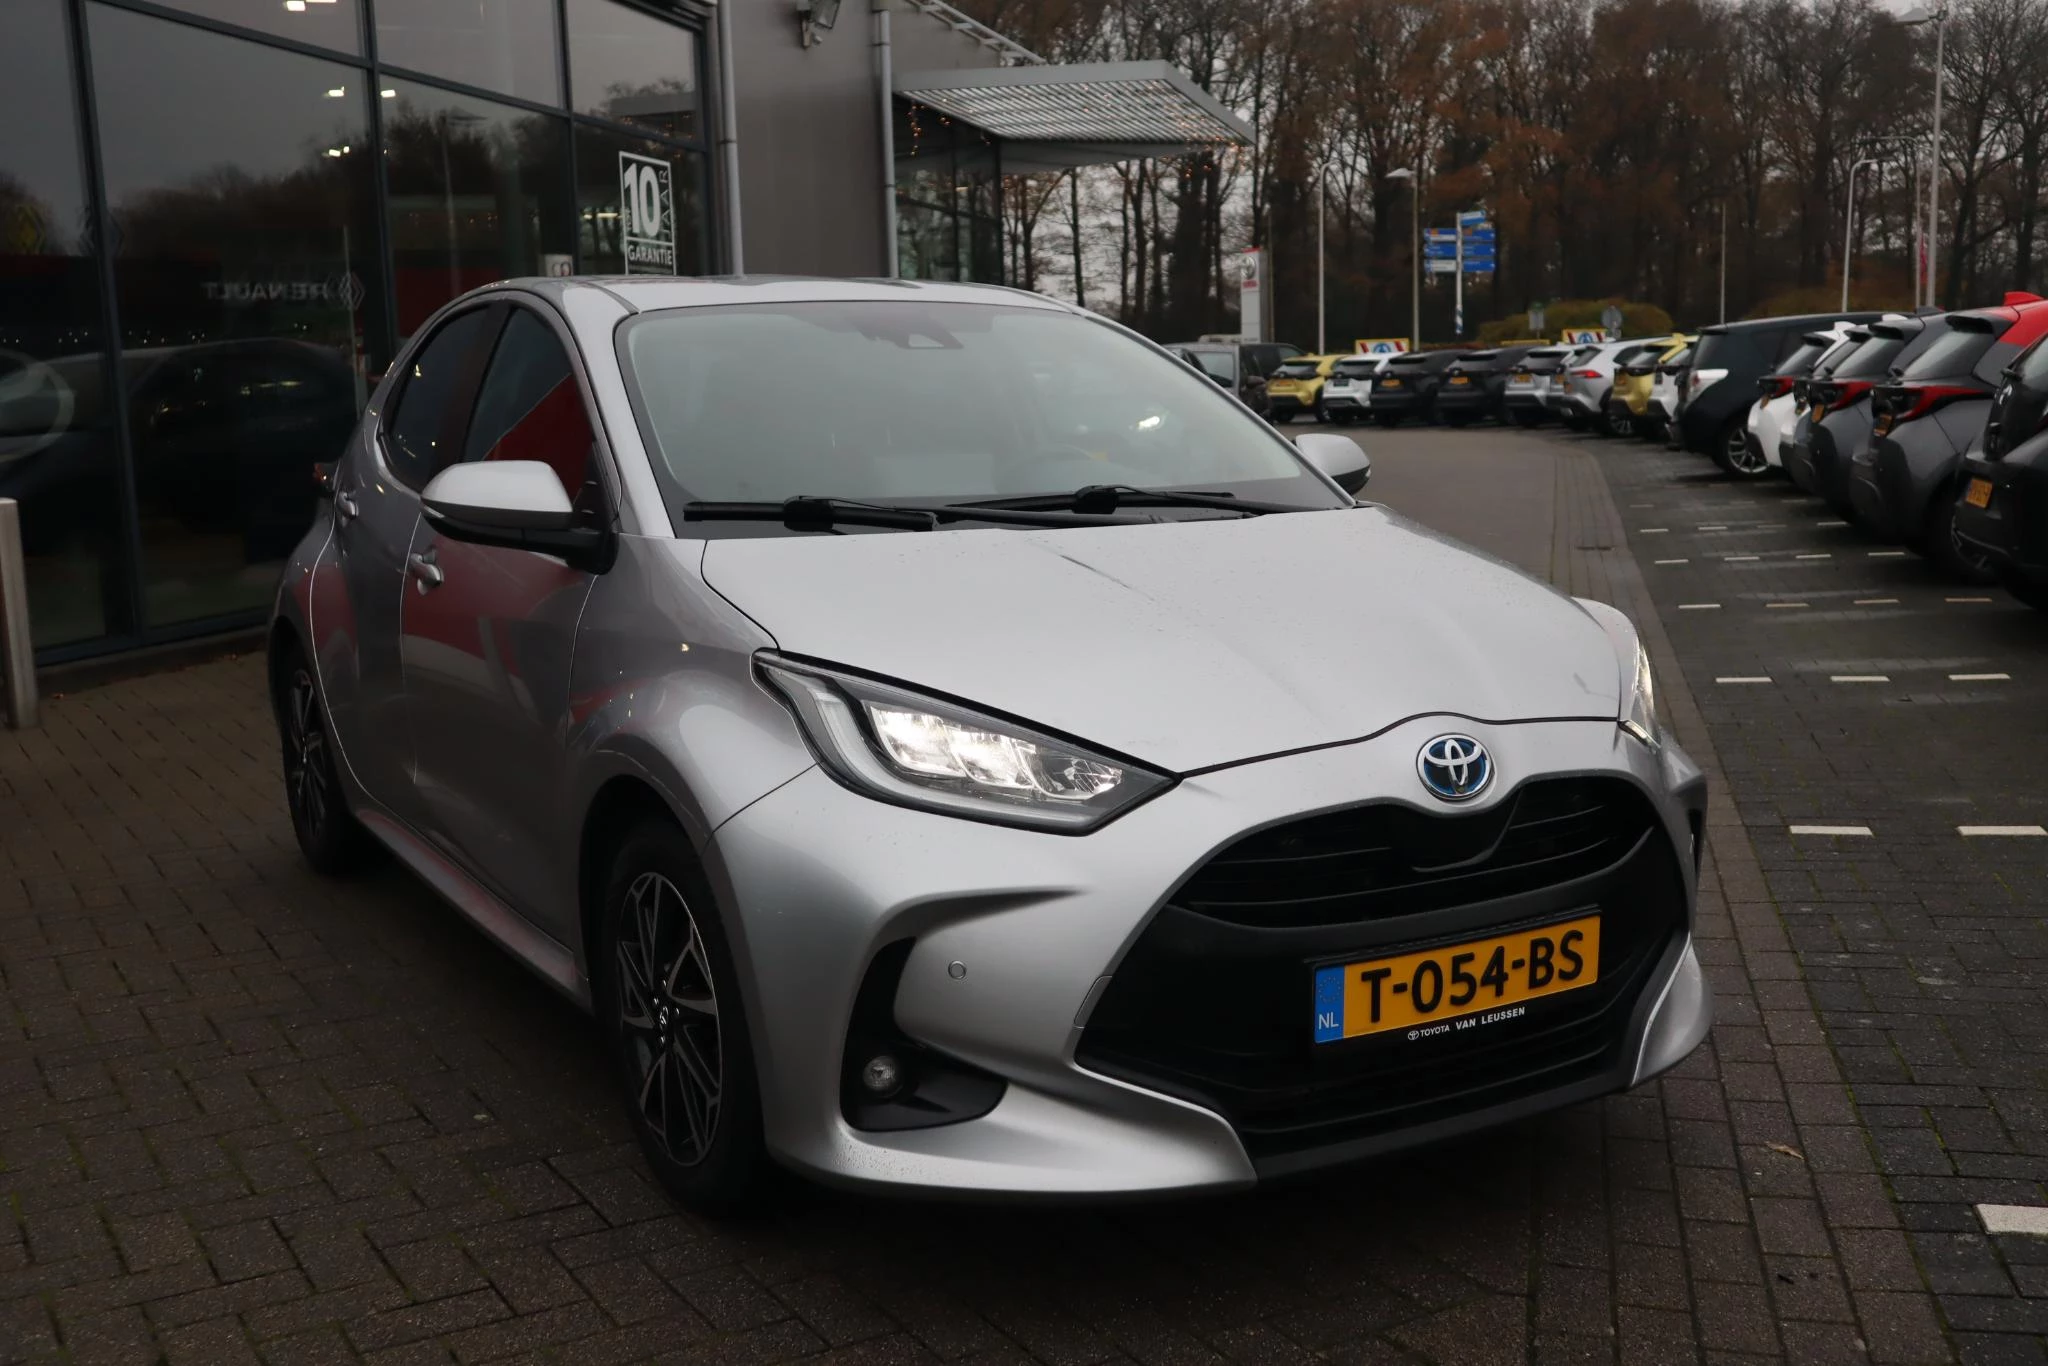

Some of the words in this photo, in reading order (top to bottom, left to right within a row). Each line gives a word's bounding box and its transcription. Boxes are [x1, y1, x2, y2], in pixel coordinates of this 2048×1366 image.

[624, 162, 660, 237] 10
[659, 170, 671, 240] JAAR
[628, 244, 672, 266] GARANTIE
[1361, 930, 1584, 1023] T-054-BS
[1318, 1011, 1339, 1030] NL
[1420, 1024, 1451, 1038] TOYOTA
[1455, 1018, 1476, 1031] VAN
[1481, 1007, 1526, 1025] LEUSSEN
